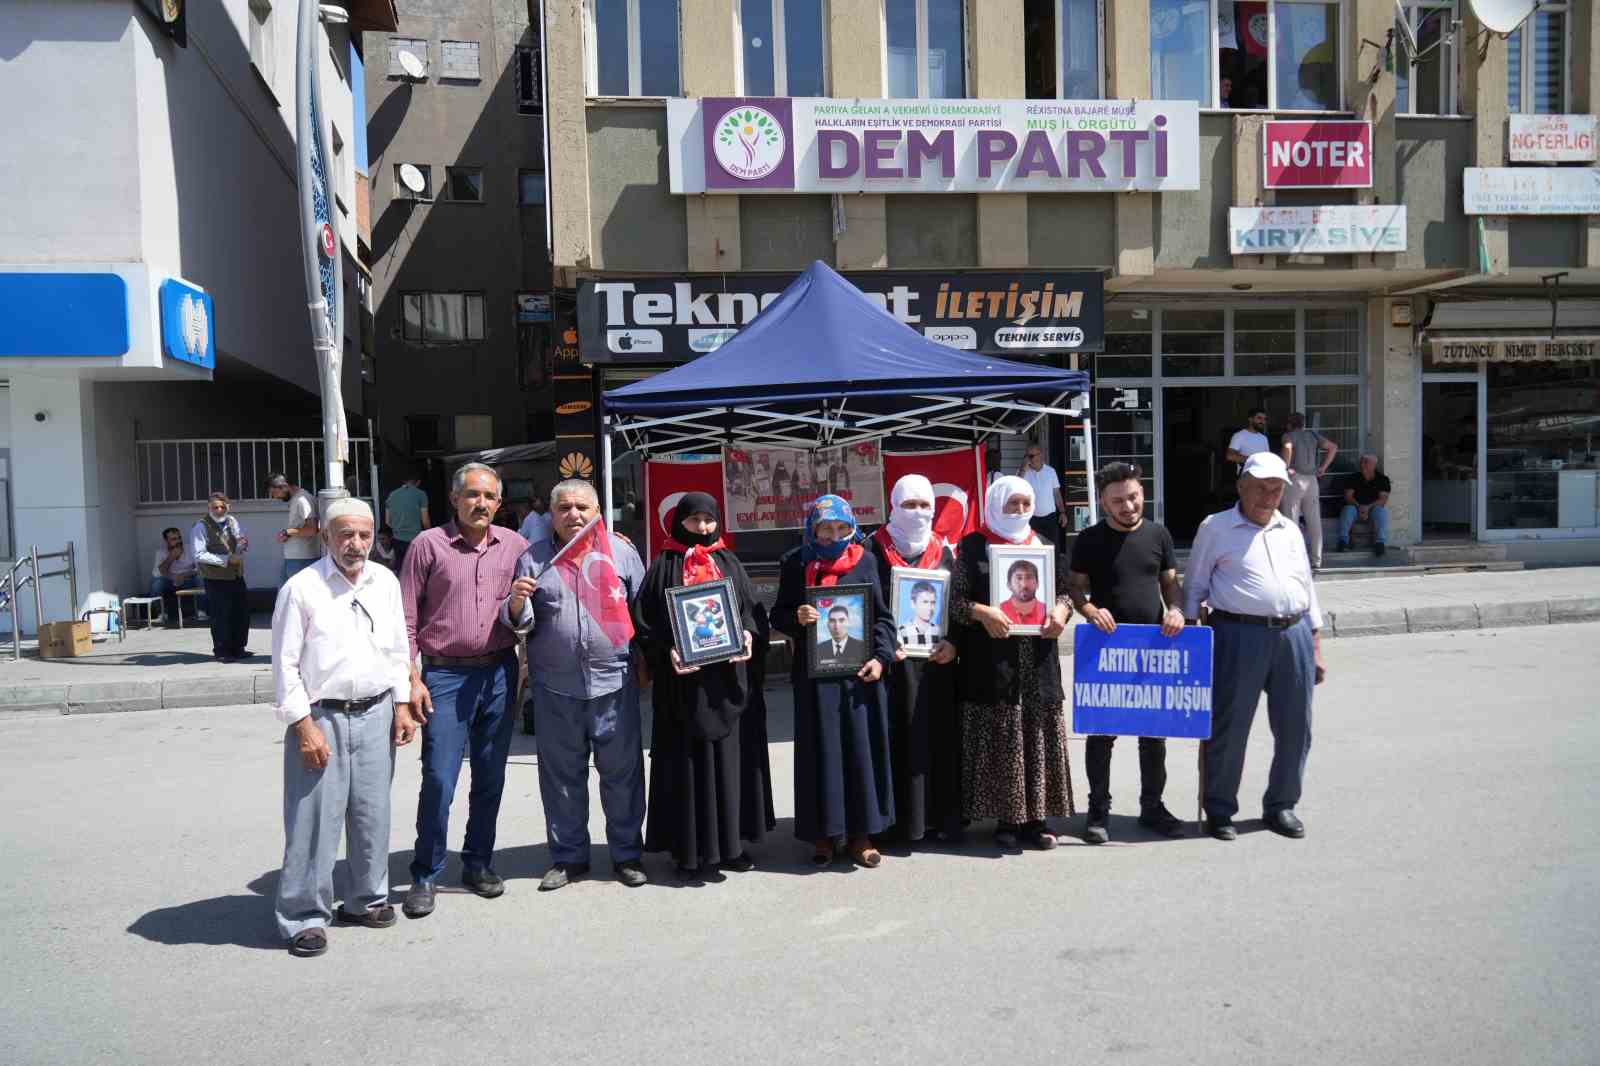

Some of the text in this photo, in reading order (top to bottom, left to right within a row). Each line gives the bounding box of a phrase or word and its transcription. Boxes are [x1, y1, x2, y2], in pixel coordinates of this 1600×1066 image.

[815, 118, 865, 127] HALKLARIN
[903, 118, 914, 127] VE
[968, 117, 1002, 127] PARTİSİ
[1027, 119, 1057, 132] MUŞ
[817, 114, 1168, 178] DEM PARTİ
[1271, 140, 1365, 168] NOTER
[1235, 225, 1402, 247] KIRTASİYE
[935, 281, 1084, 326] İLETİŞİM
[997, 331, 1082, 343] TEKNİK SERVİS
[1098, 647, 1189, 674] ARTIK YETER !
[1074, 679, 1212, 718] YAKAMIZDAN DÜŞÜN
